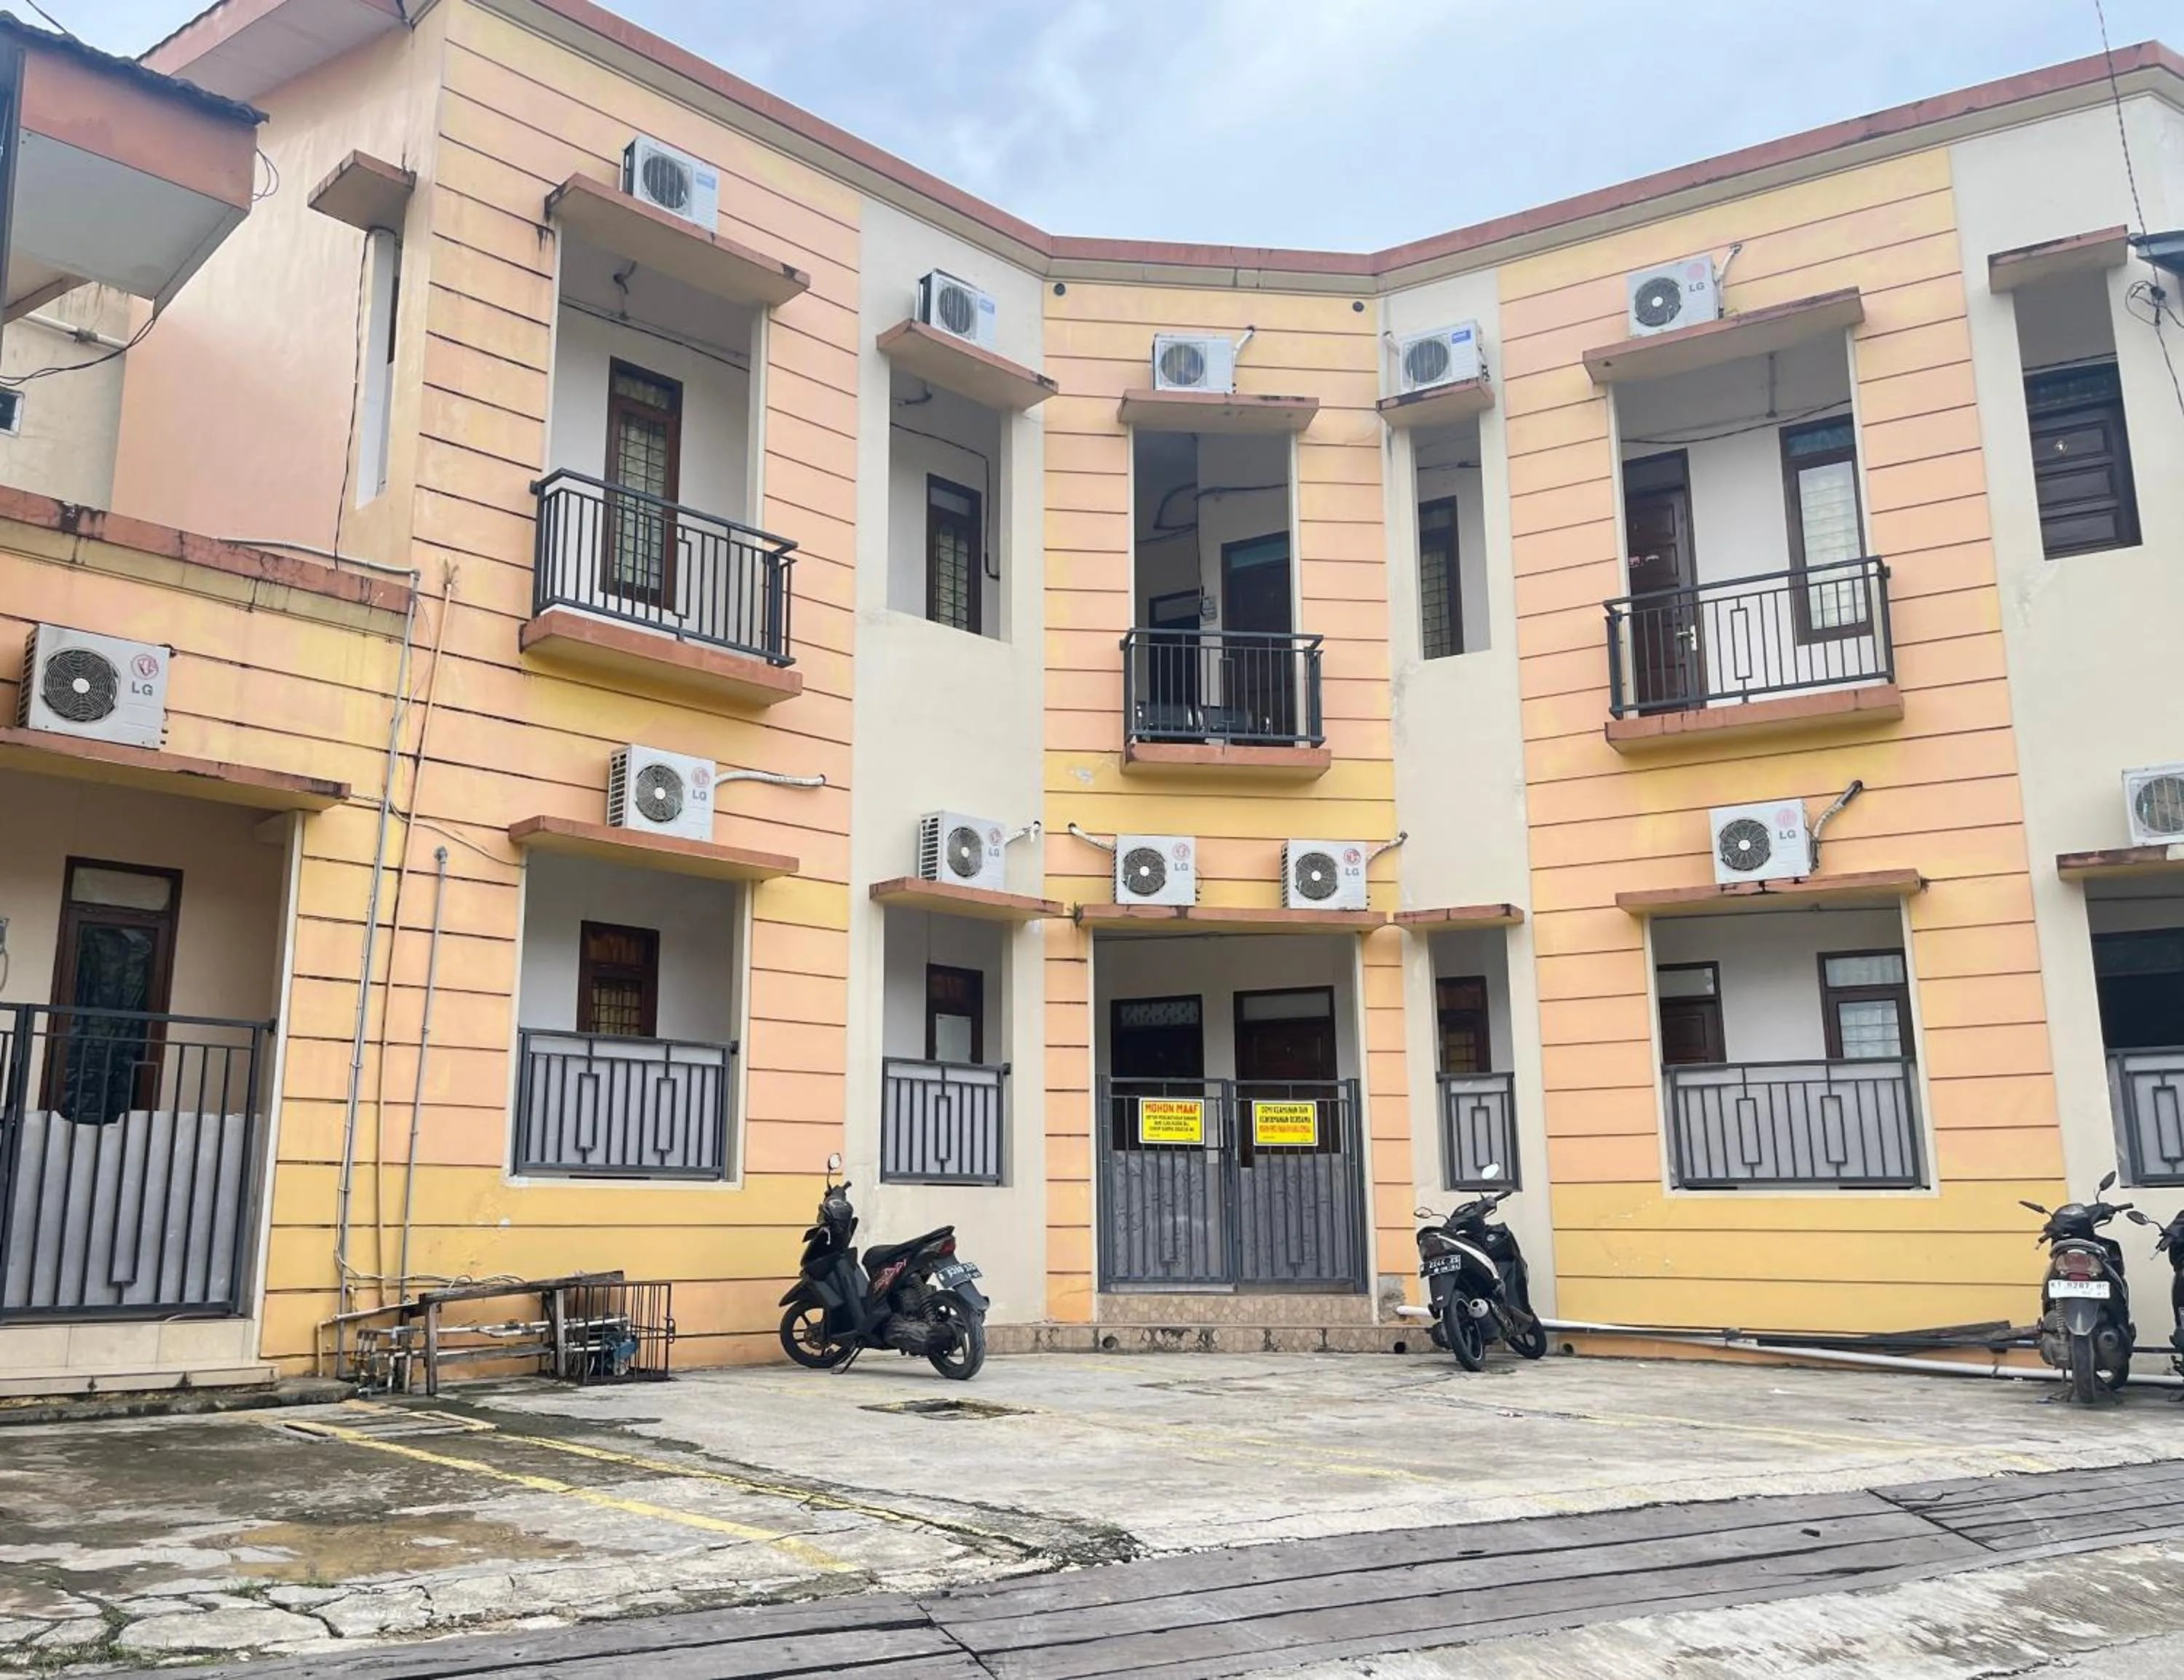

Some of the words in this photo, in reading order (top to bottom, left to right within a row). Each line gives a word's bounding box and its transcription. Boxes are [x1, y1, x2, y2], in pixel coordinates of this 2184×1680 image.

[1689, 282, 1705, 292] LG
[132, 681, 154, 697] LG
[692, 790, 708, 801] LG
[1779, 829, 1796, 839] LG
[989, 846, 1000, 857] LG
[1174, 863, 1189, 871] LG
[1345, 868, 1360, 876] LG
[1145, 1104, 1174, 1113] MOHON
[1176, 1104, 1198, 1114] MAAF
